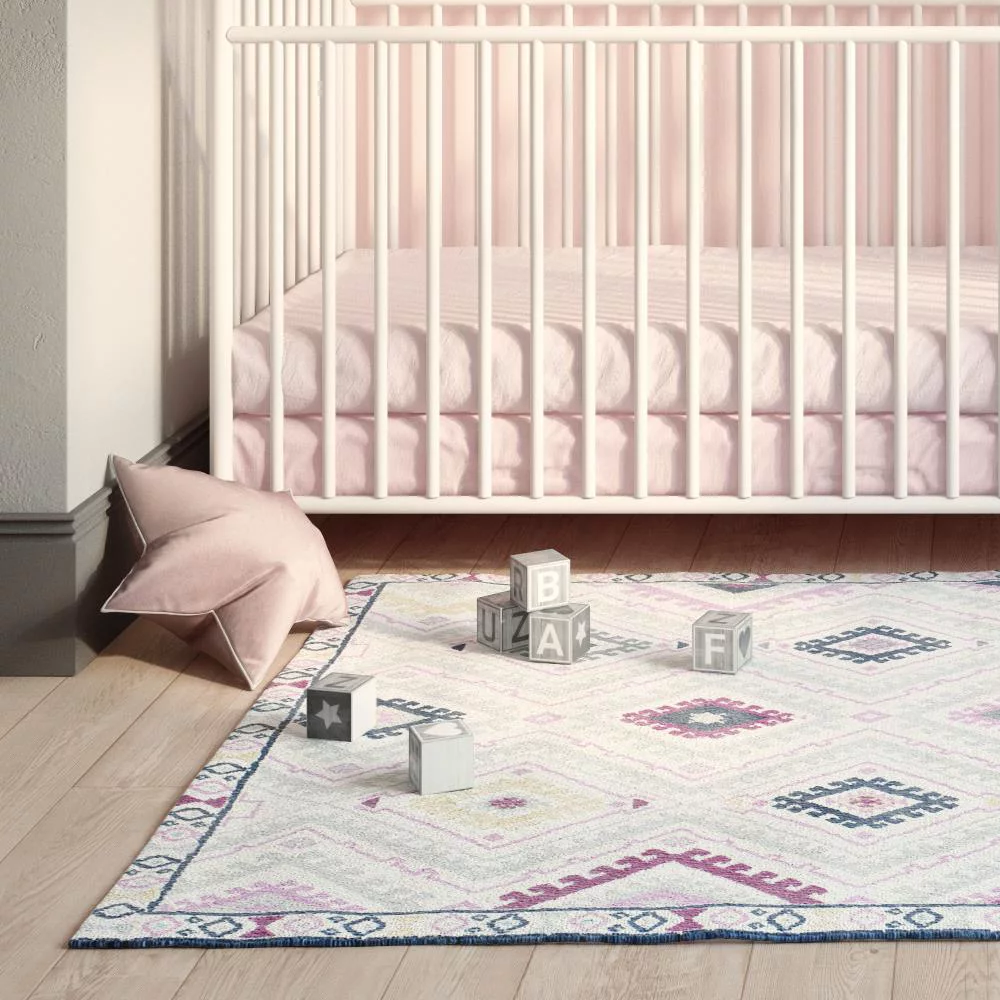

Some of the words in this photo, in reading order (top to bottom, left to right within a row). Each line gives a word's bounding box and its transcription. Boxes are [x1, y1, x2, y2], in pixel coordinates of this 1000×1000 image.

[537, 570, 560, 604] B
[481, 608, 496, 642] U
[511, 610, 530, 644] Z
[536, 622, 564, 657] A
[704, 632, 726, 665] F
